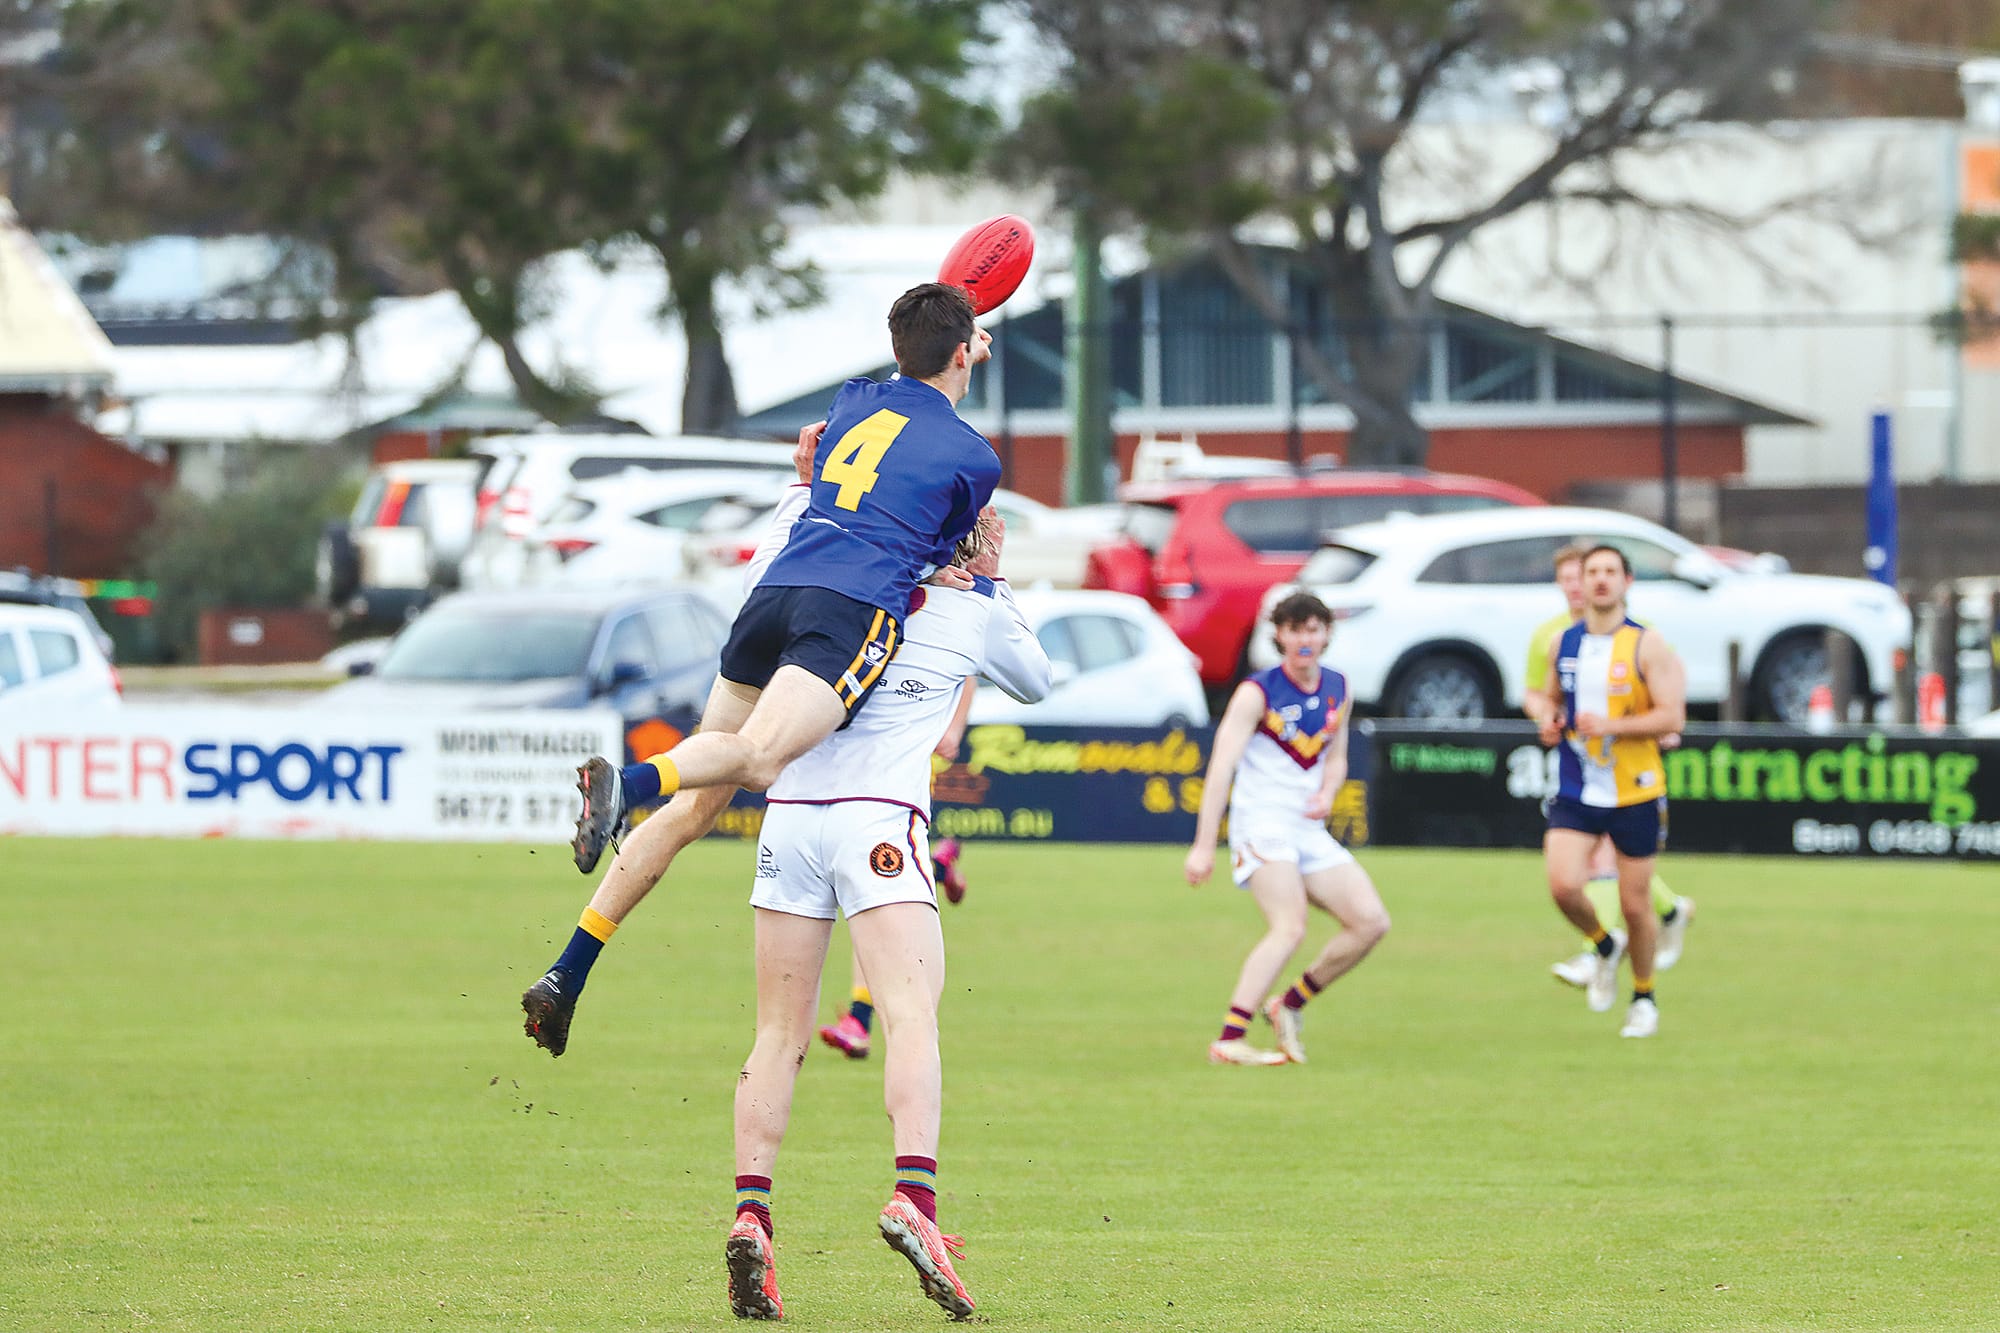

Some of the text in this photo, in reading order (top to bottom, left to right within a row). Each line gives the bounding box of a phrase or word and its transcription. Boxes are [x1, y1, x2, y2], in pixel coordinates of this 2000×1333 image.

[963, 226, 1020, 287] SHERRIN
[820, 408, 910, 512] 4
[1664, 733, 1979, 828] ntracting
[1792, 817, 1861, 853] Ben
